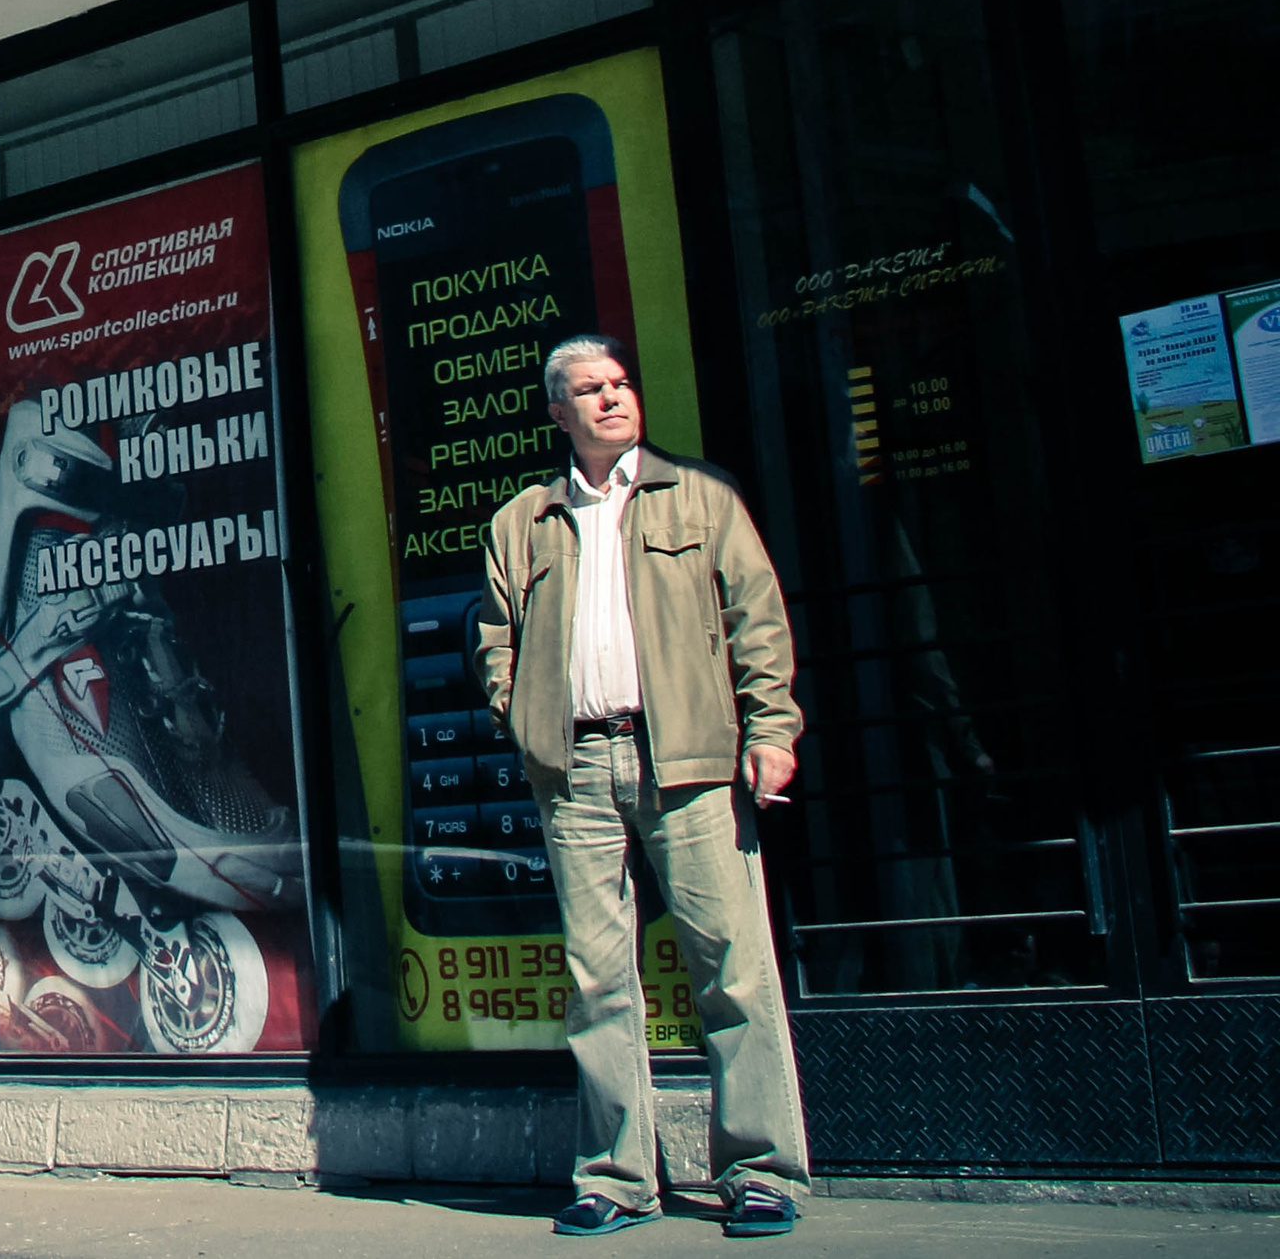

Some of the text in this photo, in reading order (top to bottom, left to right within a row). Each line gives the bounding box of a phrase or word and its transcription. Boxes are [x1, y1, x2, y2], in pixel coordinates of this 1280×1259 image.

[90, 217, 234, 272] СПОРТИВНАЯ
[377, 216, 435, 241] NOKIA
[88, 244, 216, 295] КОЛЛЕКЦИЯ
[411, 253, 550, 306] ПОКУПКА
[8, 291, 238, 361] www.sportcollection.ru
[407, 293, 561, 349] ПРОДАЖА
[434, 340, 541, 386] ОБМЕН
[40, 341, 265, 436] РОЛИКОВЫЕ
[443, 384, 539, 426] ЗАЛОГ
[910, 377, 948, 395] 10.00
[912, 396, 952, 415] 19.00
[120, 411, 269, 485] КОНЬКИ
[430, 424, 557, 469] РЕМОНТ
[1146, 431, 1190, 453] ОКЕАН
[419, 467, 559, 514] ЗАПЧАСТ
[36, 509, 279, 595] АКСЕССУАРЫ
[404, 522, 491, 559] АКСЕС
[421, 728, 428, 746] 1
[423, 773, 459, 791] 4 GHI
[497, 768, 509, 787] 5
[425, 820, 467, 838] 7 PQRS
[501, 815, 513, 834] 8
[505, 863, 518, 881] 0
[438, 939, 688, 979] 8 911 39 9
[442, 989, 461, 1021] 8
[469, 988, 538, 1021] 965
[547, 987, 574, 1020] 8
[672, 983, 699, 1018] 8
[656, 1025, 702, 1041] ВРЕМ
